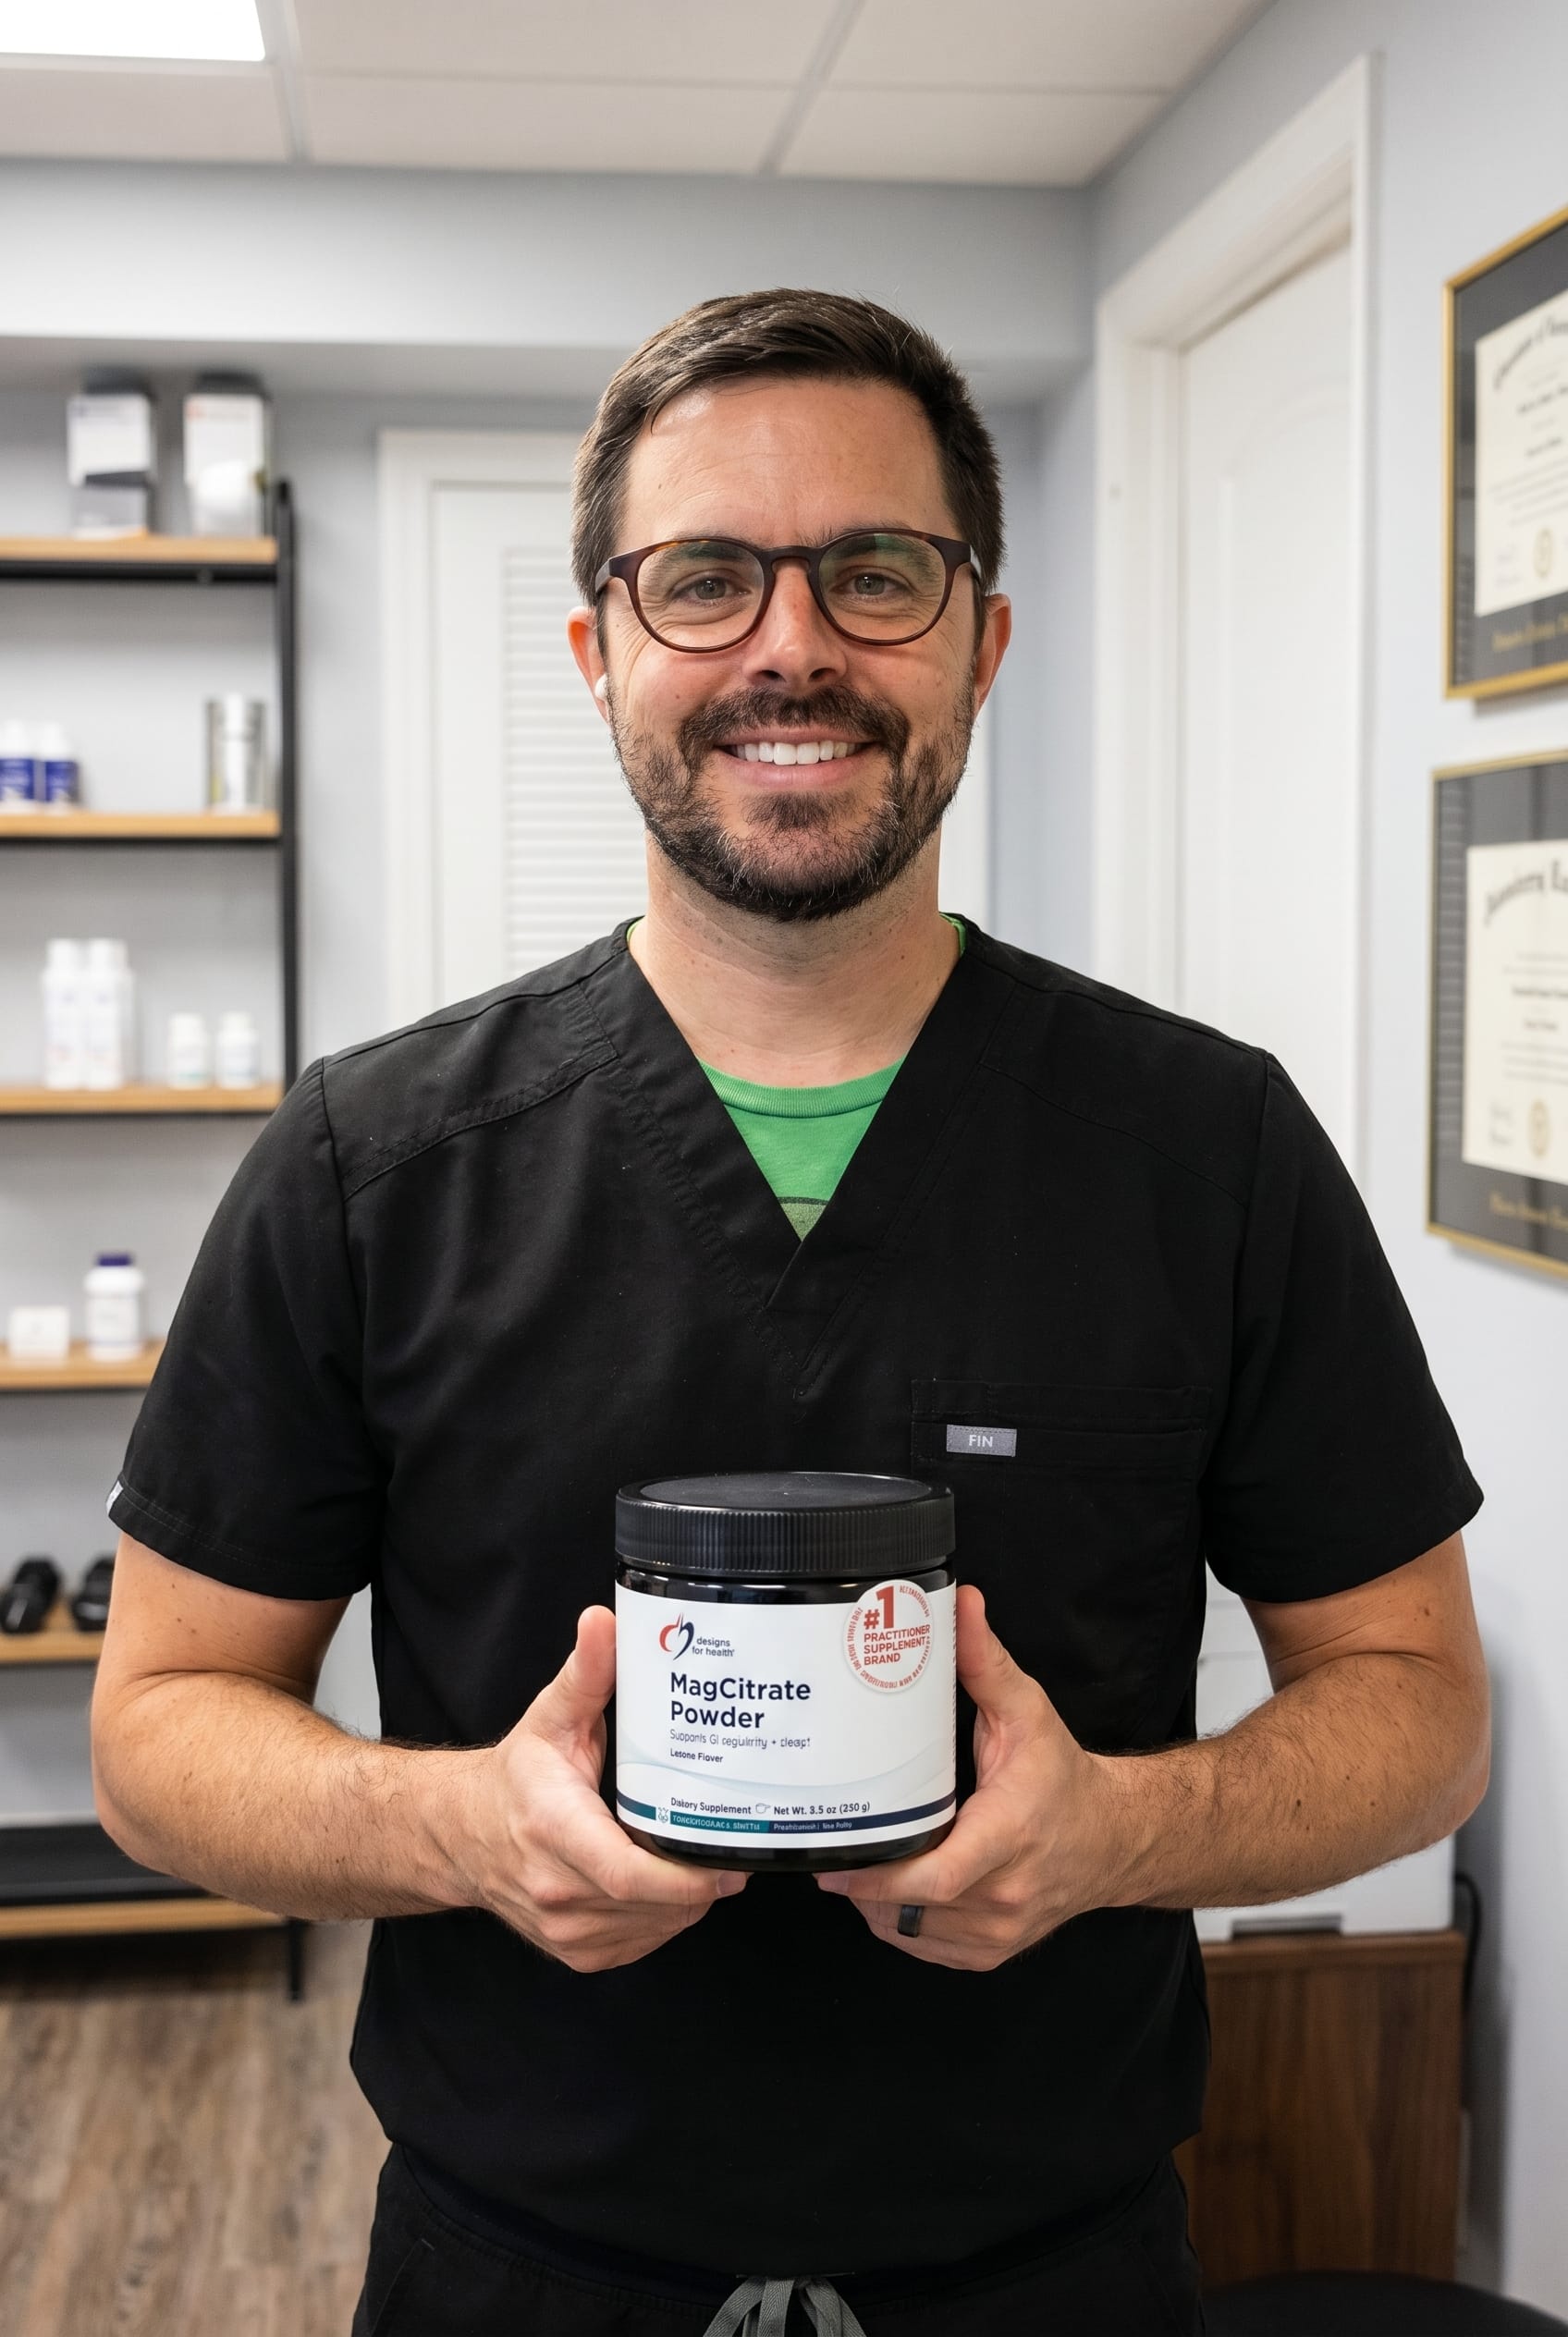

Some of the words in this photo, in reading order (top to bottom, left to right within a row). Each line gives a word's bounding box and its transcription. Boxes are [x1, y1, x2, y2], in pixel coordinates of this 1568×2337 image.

[969, 1434, 994, 1448] FIN
[864, 1585, 895, 1630] #1
[696, 1636, 730, 1647] designs
[864, 1624, 931, 1643] PRACTITIONER
[692, 1646, 703, 1655] for
[864, 1636, 925, 1655] SUPPLEMENT
[864, 1652, 901, 1666] BRAND
[670, 1671, 811, 1701] MagCitrate
[670, 1700, 765, 1728] Powder
[699, 1802, 752, 1815] Supplement
[774, 1805, 790, 1816] Net
[791, 1805, 807, 1816] Wt.
[809, 1805, 824, 1815] 3.5
[826, 1805, 837, 1814] oz
[839, 1802, 860, 1815] (250
[861, 1801, 871, 1813] g)
